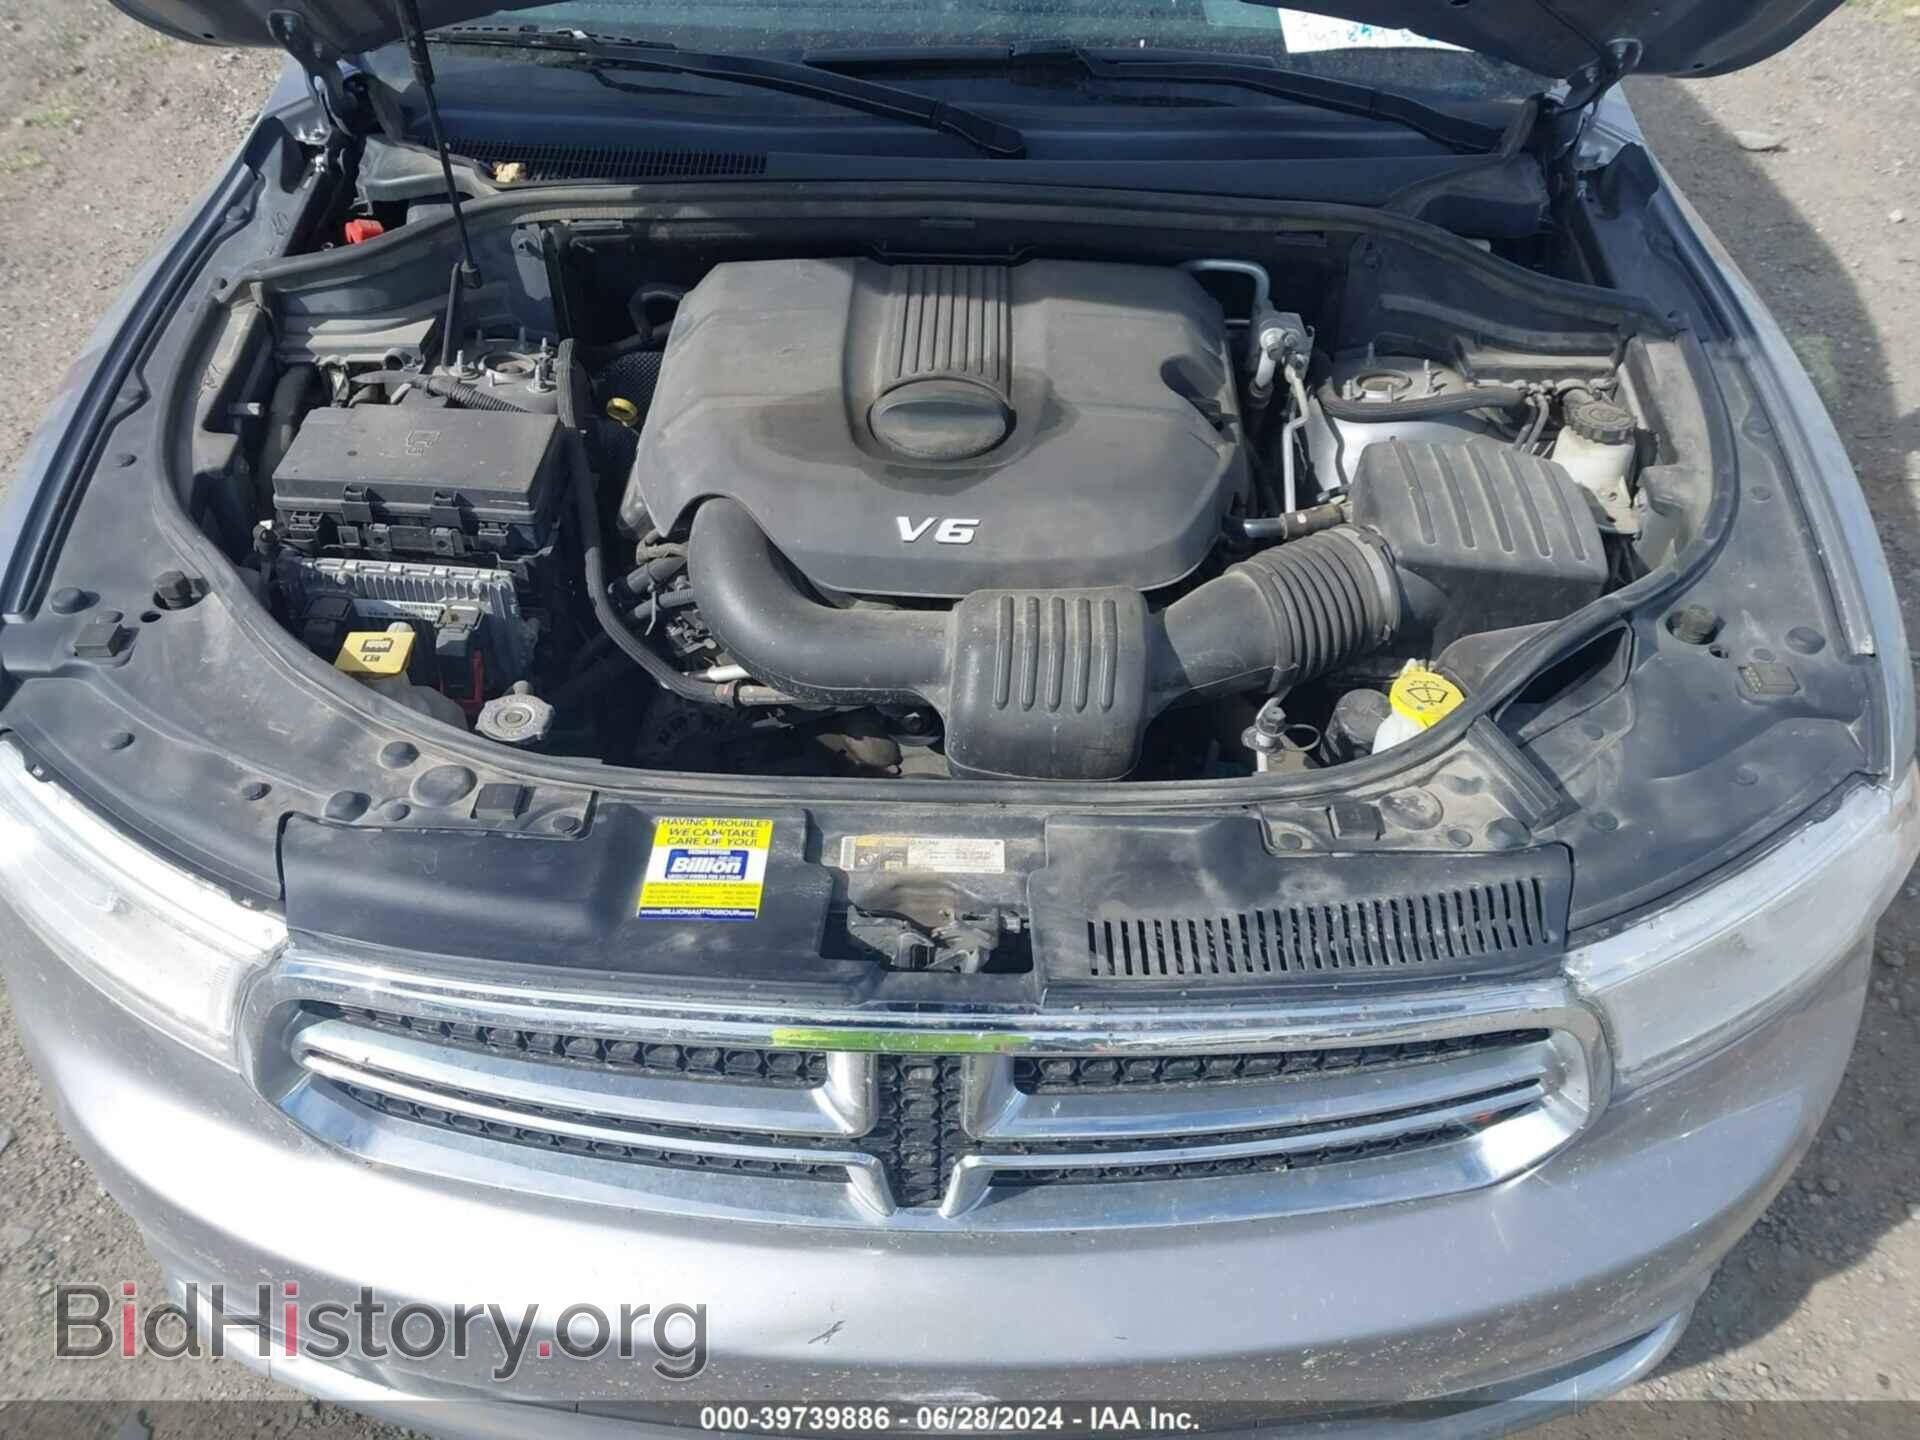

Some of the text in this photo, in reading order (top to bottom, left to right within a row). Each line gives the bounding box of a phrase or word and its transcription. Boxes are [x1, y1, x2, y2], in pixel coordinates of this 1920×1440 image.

[896, 516, 981, 544] V6
[661, 817, 770, 828] HAVING TROUBLE?
[669, 828, 688, 836] WE
[724, 829, 758, 837] TAKE
[704, 838, 721, 846] OF
[727, 838, 757, 847] YOU!
[670, 856, 743, 874] Billion
